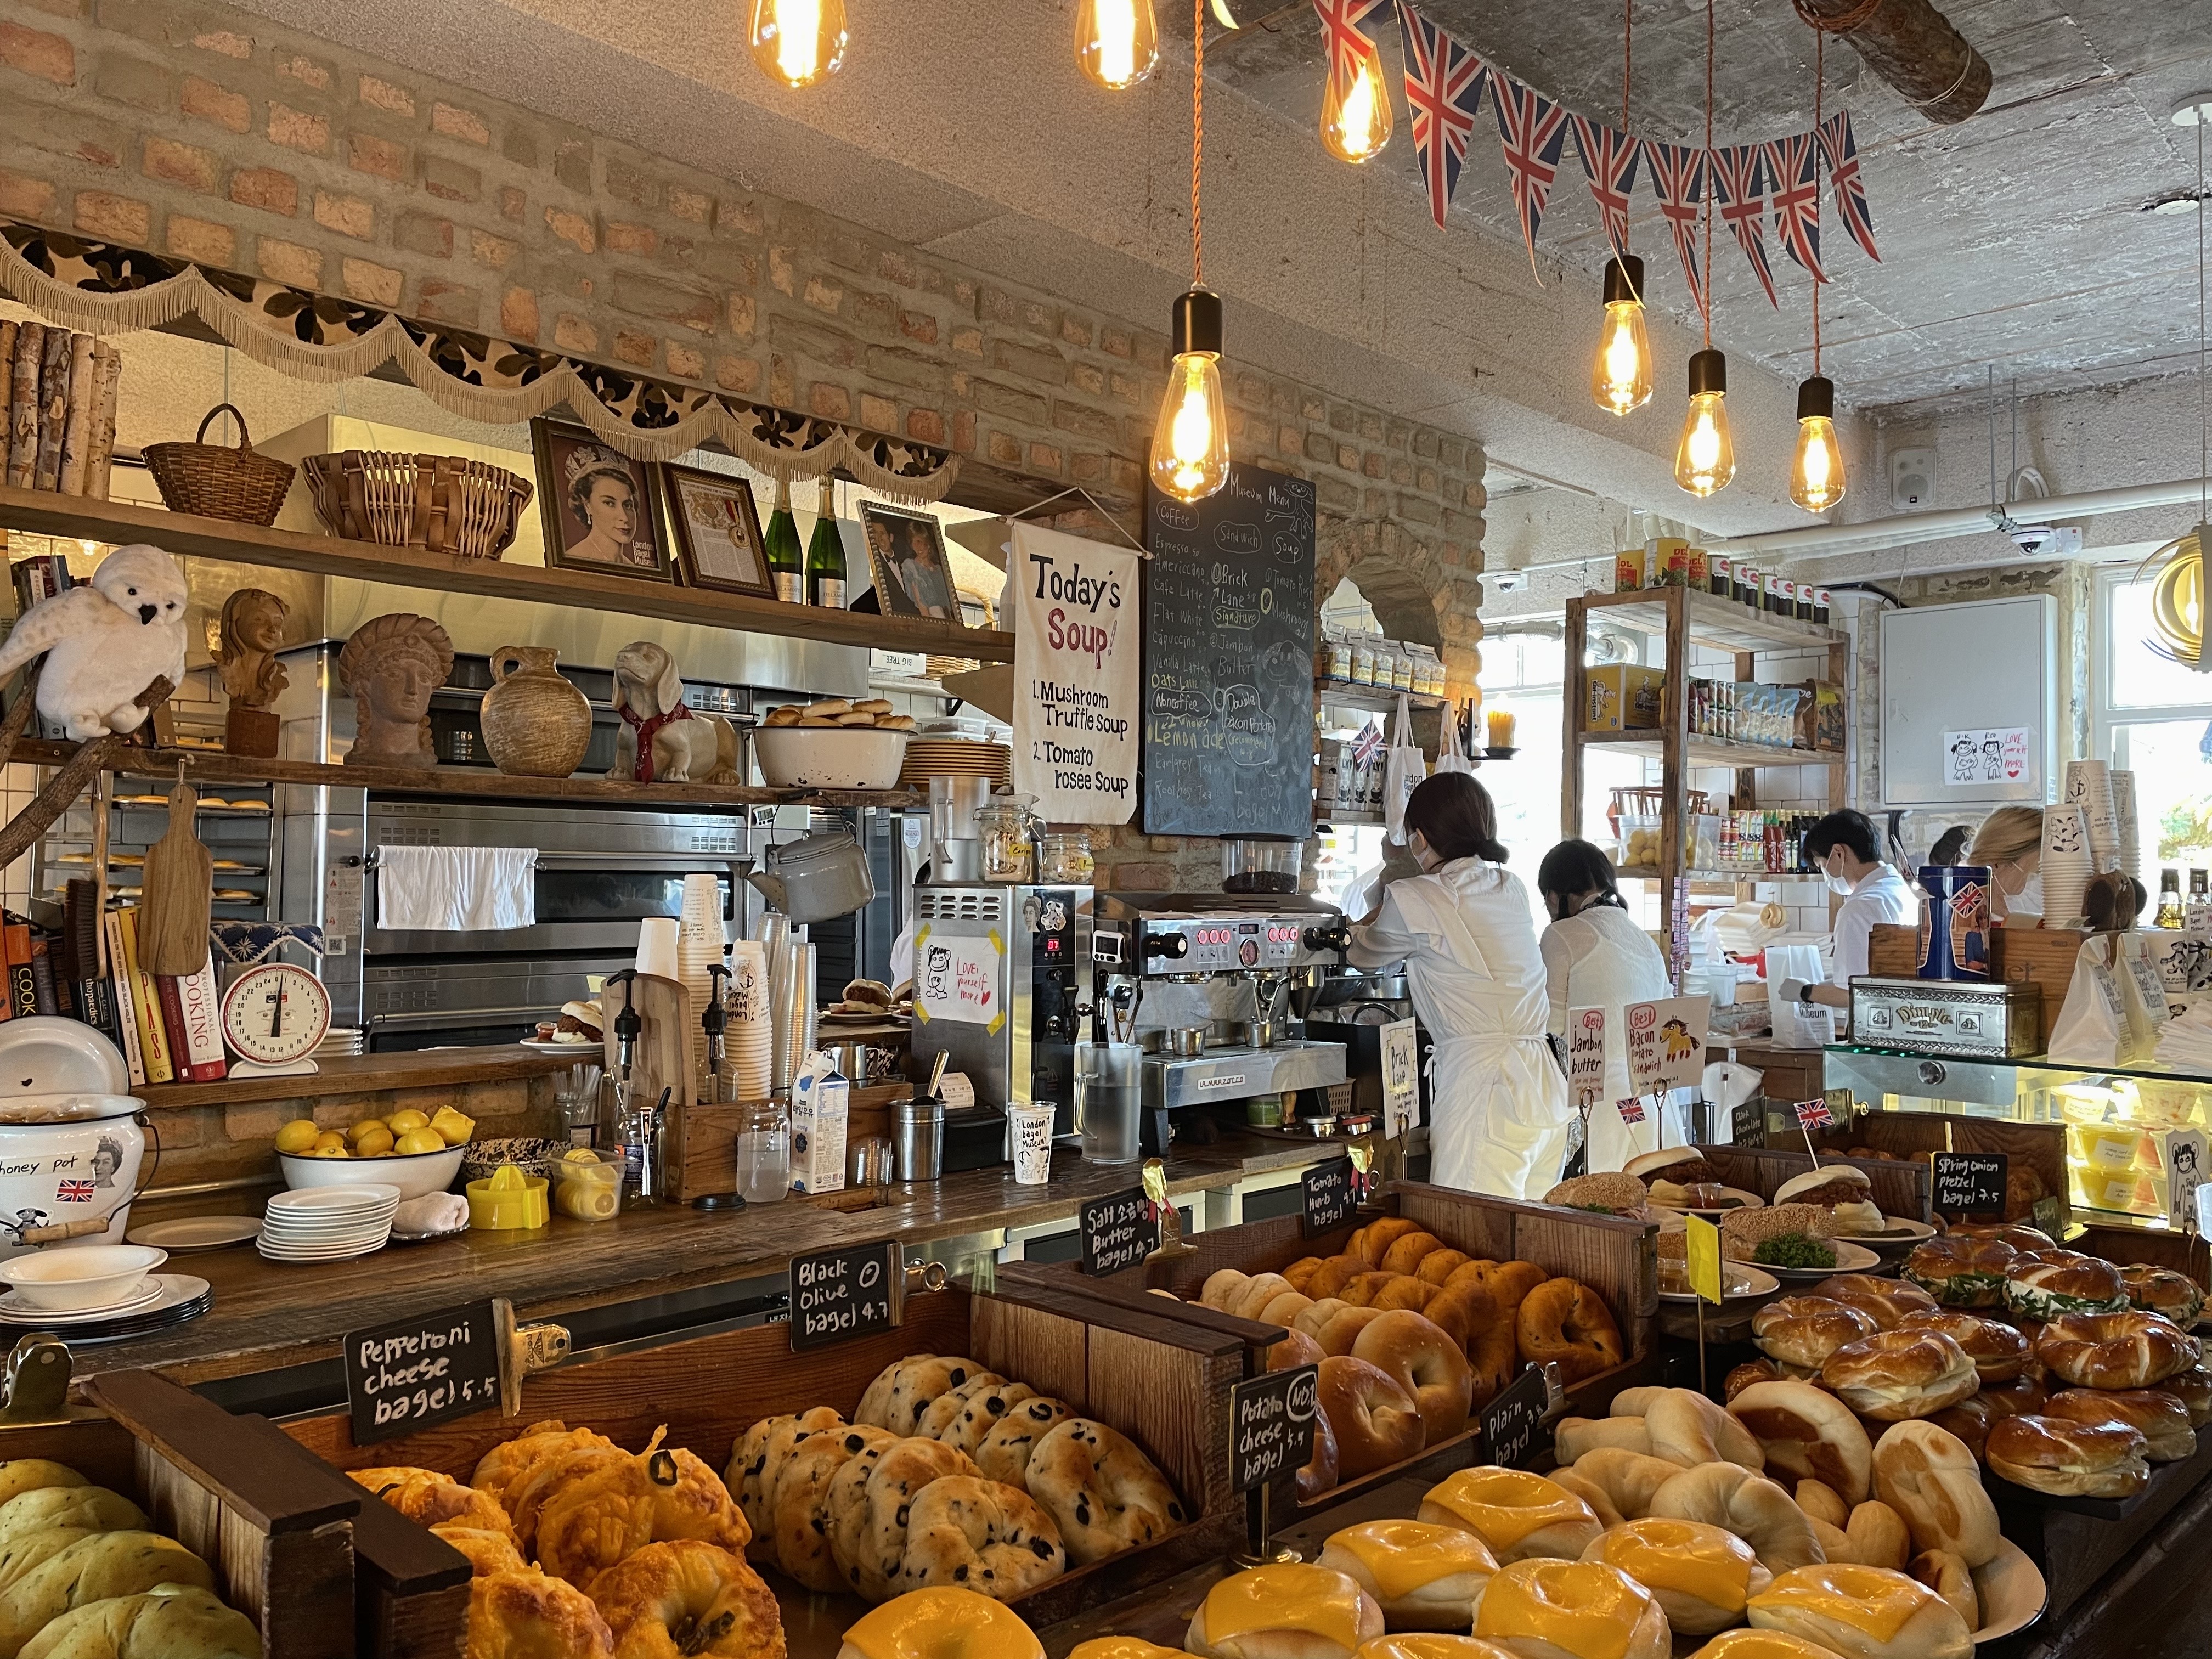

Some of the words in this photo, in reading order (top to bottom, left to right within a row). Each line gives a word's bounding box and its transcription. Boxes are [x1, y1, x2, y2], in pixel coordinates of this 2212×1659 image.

[1231, 472, 1262, 504] Museum
[1269, 484, 1289, 508] Menu
[632, 539, 654, 551] London
[633, 548, 650, 558] Bagel
[1155, 533, 1189, 556] Espresso
[1276, 537, 1299, 564] Soup
[1030, 553, 1121, 613] Today's
[1222, 564, 1248, 588] Brick
[1180, 580, 1203, 602] Latte
[1222, 589, 1244, 608] Lane
[1153, 602, 1175, 624] Flat
[1180, 610, 1203, 627] White
[1216, 609, 1256, 625] Signature
[1272, 602, 1308, 629] Mushroom
[1048, 608, 1118, 669] Soup!
[1220, 634, 1253, 654] Jambon
[886, 655, 900, 664] TREE
[902, 657, 912, 666] BIG
[1153, 653, 1179, 673] Vanilla
[1183, 655, 1204, 675] Latte
[1218, 655, 1255, 676] Butter
[1152, 673, 1176, 688] Oats
[1041, 681, 1108, 708] Mushroom
[1227, 692, 1256, 713] Double
[1042, 703, 1094, 730] Truffle
[1096, 714, 1128, 741] Soup
[1155, 719, 1197, 749] Lemon
[2005, 733, 2023, 744] LOVE
[1043, 741, 1093, 766] Tomato
[2005, 759, 2025, 769] MORE
[1054, 768, 1092, 790] rosée
[1095, 771, 1128, 799] Soup
[1048, 940, 1059, 950] 87
[19, 968, 36, 1015] COOK
[129, 912, 161, 1060] TPAS
[958, 973, 988, 991] yourself
[201, 971, 216, 1034] PROFESSIONAL
[961, 989, 979, 1005] more
[1634, 1009, 1652, 1026] Best
[1570, 1025, 1602, 1053] jambon
[1629, 1029, 1655, 1048] Bacon
[1391, 1045, 1409, 1069] Brick
[1572, 1057, 1602, 1074] butter
[1633, 1057, 1661, 1074] sandwich
[793, 1105, 814, 1119] 매일우유
[1022, 1117, 1046, 1129] London
[1023, 1128, 1042, 1141] bagel
[0, 1161, 40, 1175] honey
[53, 1155, 78, 1172] pot
[1971, 1159, 1999, 1172] onion
[1307, 1173, 1341, 1192] Tomato
[1943, 1189, 1975, 1206] bagel
[1979, 1188, 2000, 1203] 7.5
[1087, 1205, 1114, 1234] Salt
[1314, 1204, 1342, 1226] bagel
[1093, 1227, 1136, 1255] Butter
[1097, 1244, 1132, 1269] bagel
[1135, 1237, 1154, 1259] 4.7
[799, 1260, 848, 1286] Black
[800, 1284, 848, 1310] Olive
[806, 1303, 856, 1335] bagel
[862, 1301, 888, 1321] 4.7
[360, 1321, 471, 1369] Pepperoni
[364, 1356, 450, 1395] cheese
[374, 1379, 455, 1425] bagel
[462, 1376, 497, 1401] 5.5
[1242, 1395, 1283, 1426] Potato
[1240, 1421, 1283, 1454] cheese
[1496, 1424, 1528, 1466] bagel
[1244, 1442, 1283, 1484] bagel
